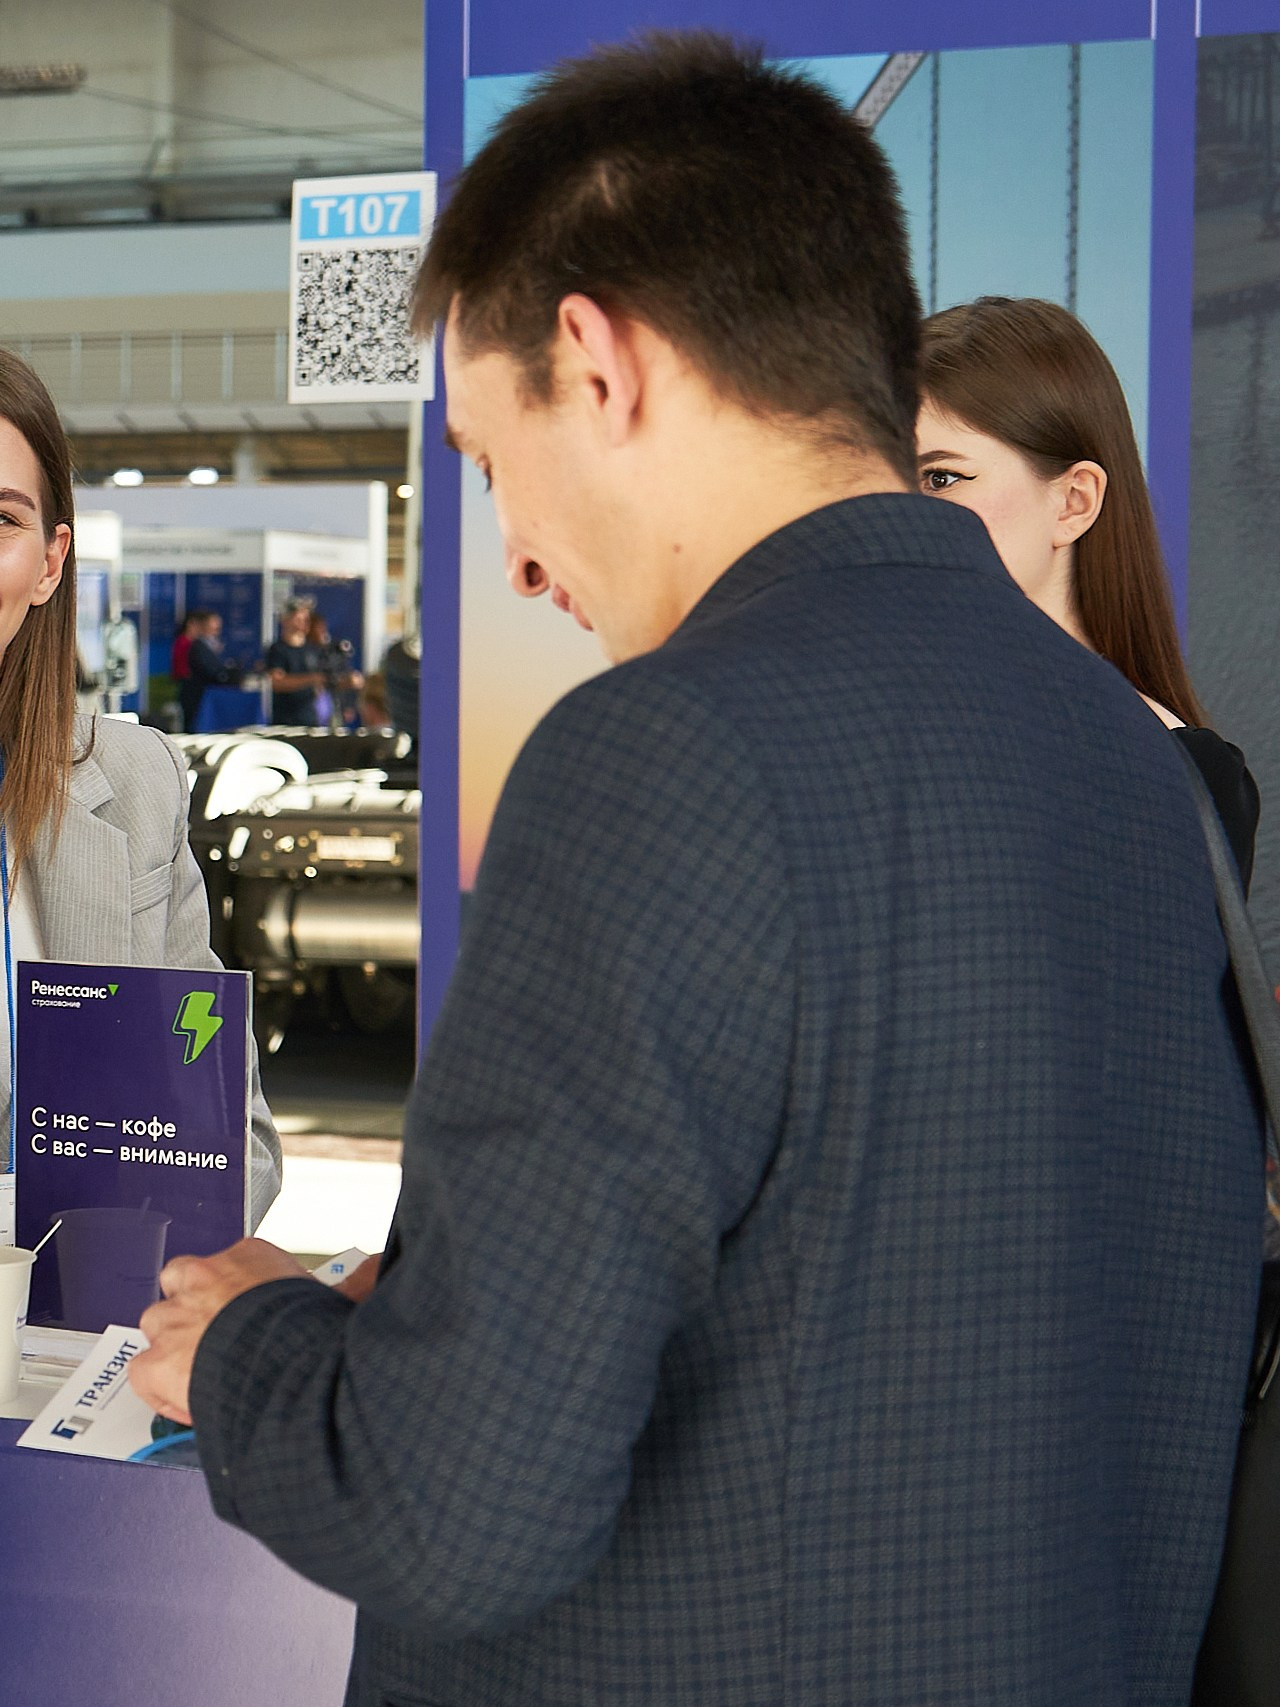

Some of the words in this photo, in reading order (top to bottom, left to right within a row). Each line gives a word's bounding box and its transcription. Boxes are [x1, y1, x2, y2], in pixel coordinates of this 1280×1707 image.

[310, 194, 409, 236] T107
[31, 980, 107, 999] Ренессанс
[31, 998, 81, 1009] страхование
[31, 1106, 47, 1127] С
[53, 1114, 90, 1131] нас
[122, 1116, 177, 1142] кофе
[31, 1133, 47, 1153] С
[52, 1140, 88, 1157] вас
[120, 1146, 228, 1169] внимание
[75, 1339, 138, 1409] ТРАНЗИТ
